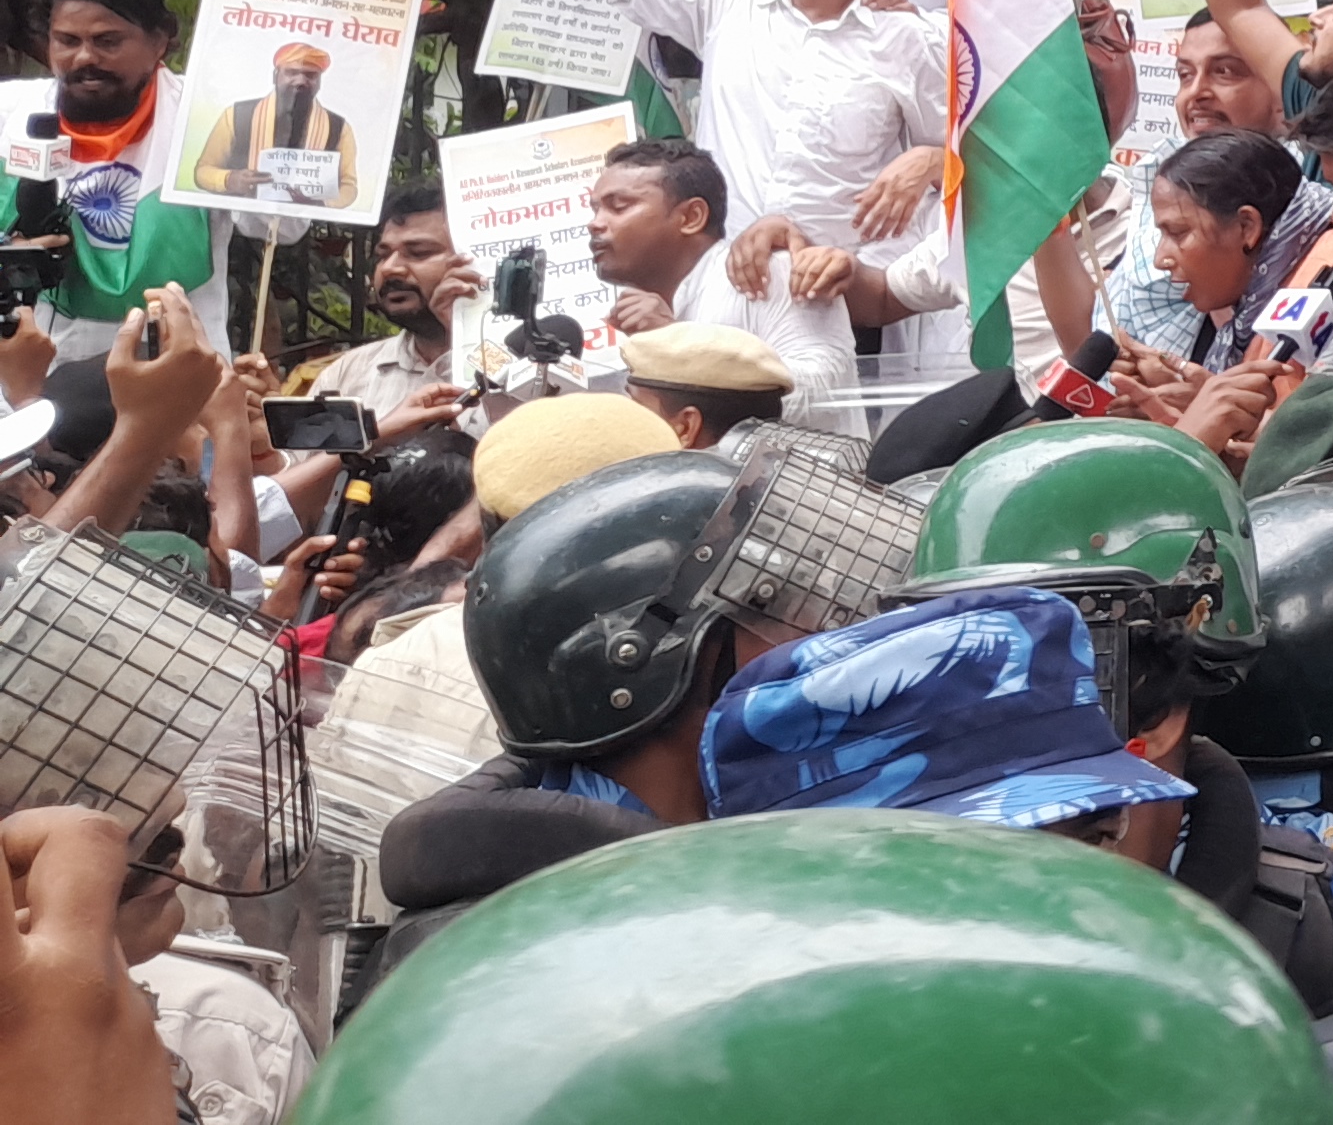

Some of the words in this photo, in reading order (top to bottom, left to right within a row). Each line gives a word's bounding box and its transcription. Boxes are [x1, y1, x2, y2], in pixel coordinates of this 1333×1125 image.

[223, 1, 333, 37] लोकभवन
[342, 16, 402, 47] घेराव
[1144, 117, 1178, 139] करो।
[470, 198, 571, 230] लोकभवन
